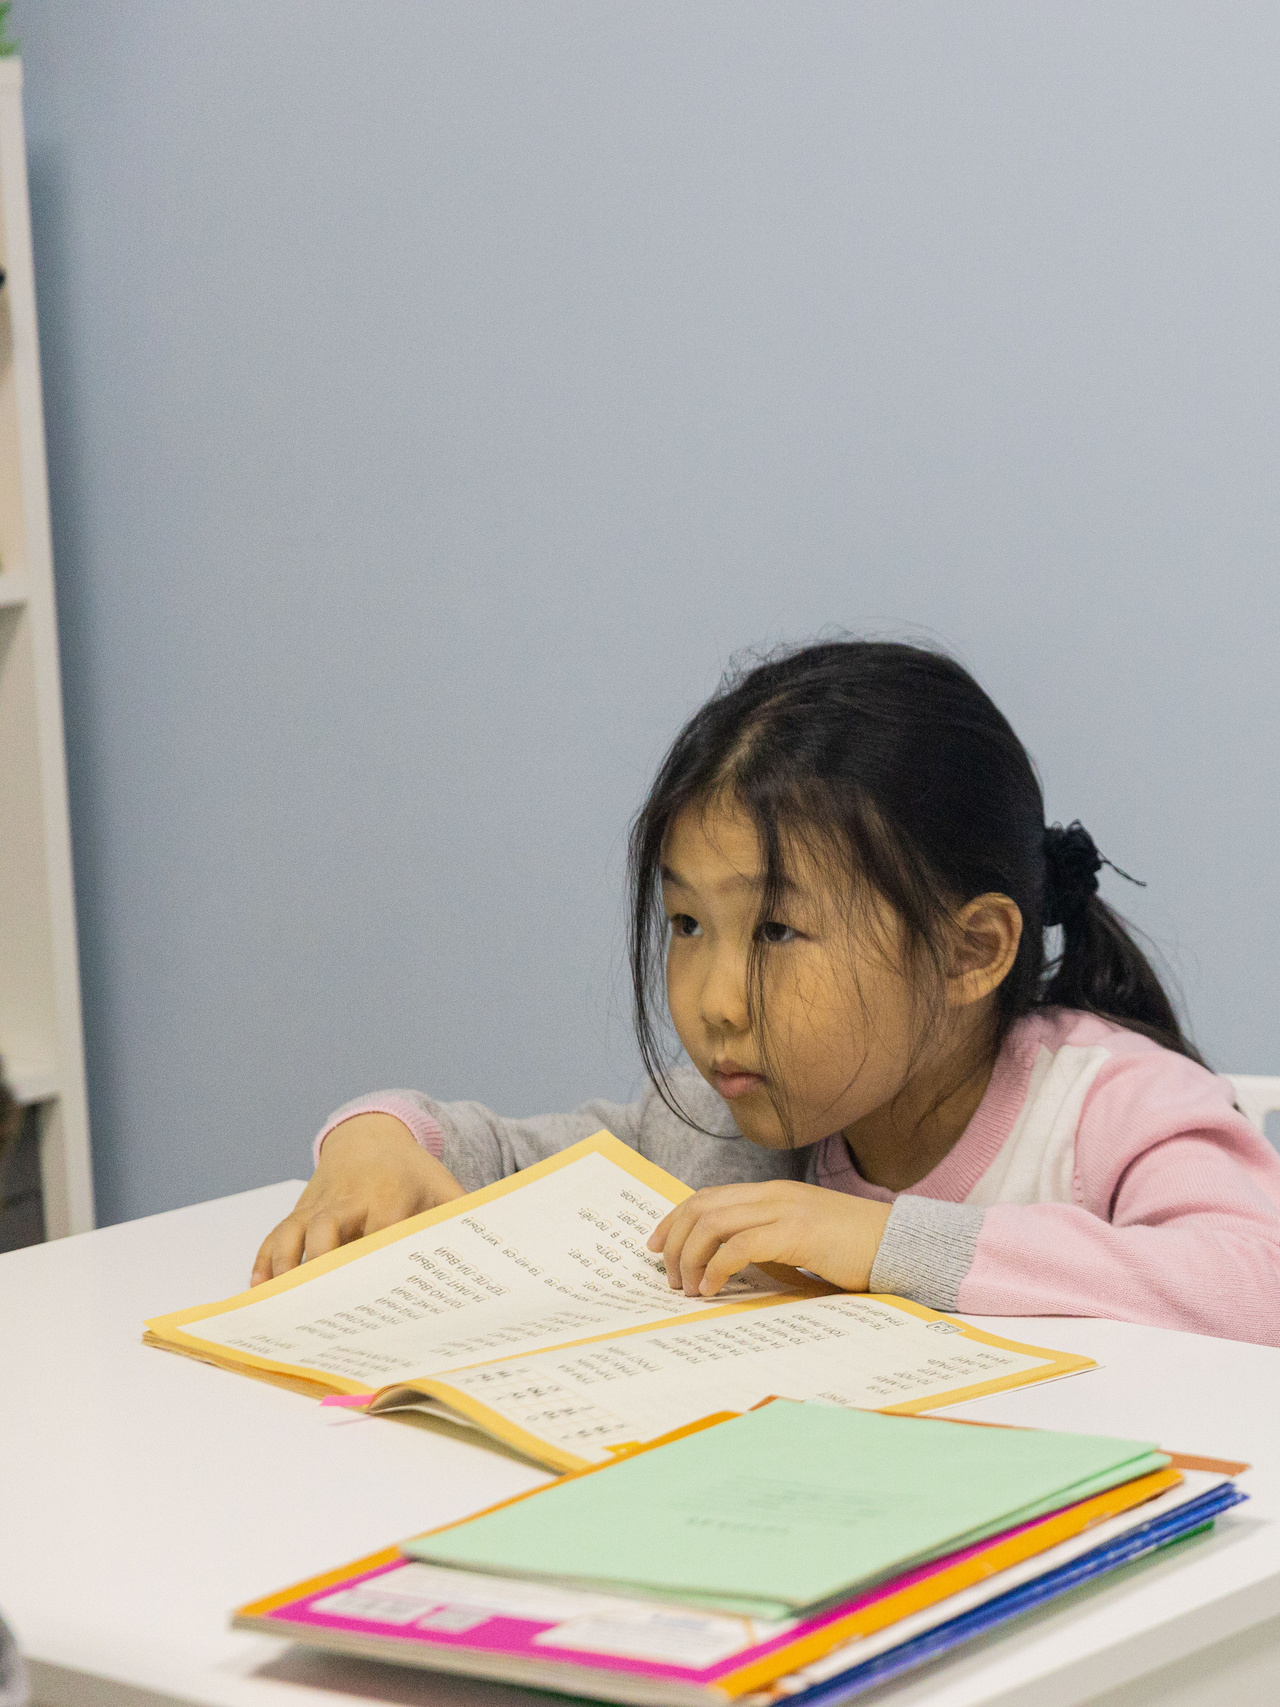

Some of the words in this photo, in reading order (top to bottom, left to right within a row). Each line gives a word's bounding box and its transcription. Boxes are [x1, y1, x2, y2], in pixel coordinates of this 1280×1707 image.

[620, 1190, 660, 1220] пе-ту-хов.
[461, 1218, 499, 1246] хит-рый
[502, 1249, 540, 1276] та-ил-ся
[593, 1268, 612, 1279] рту
